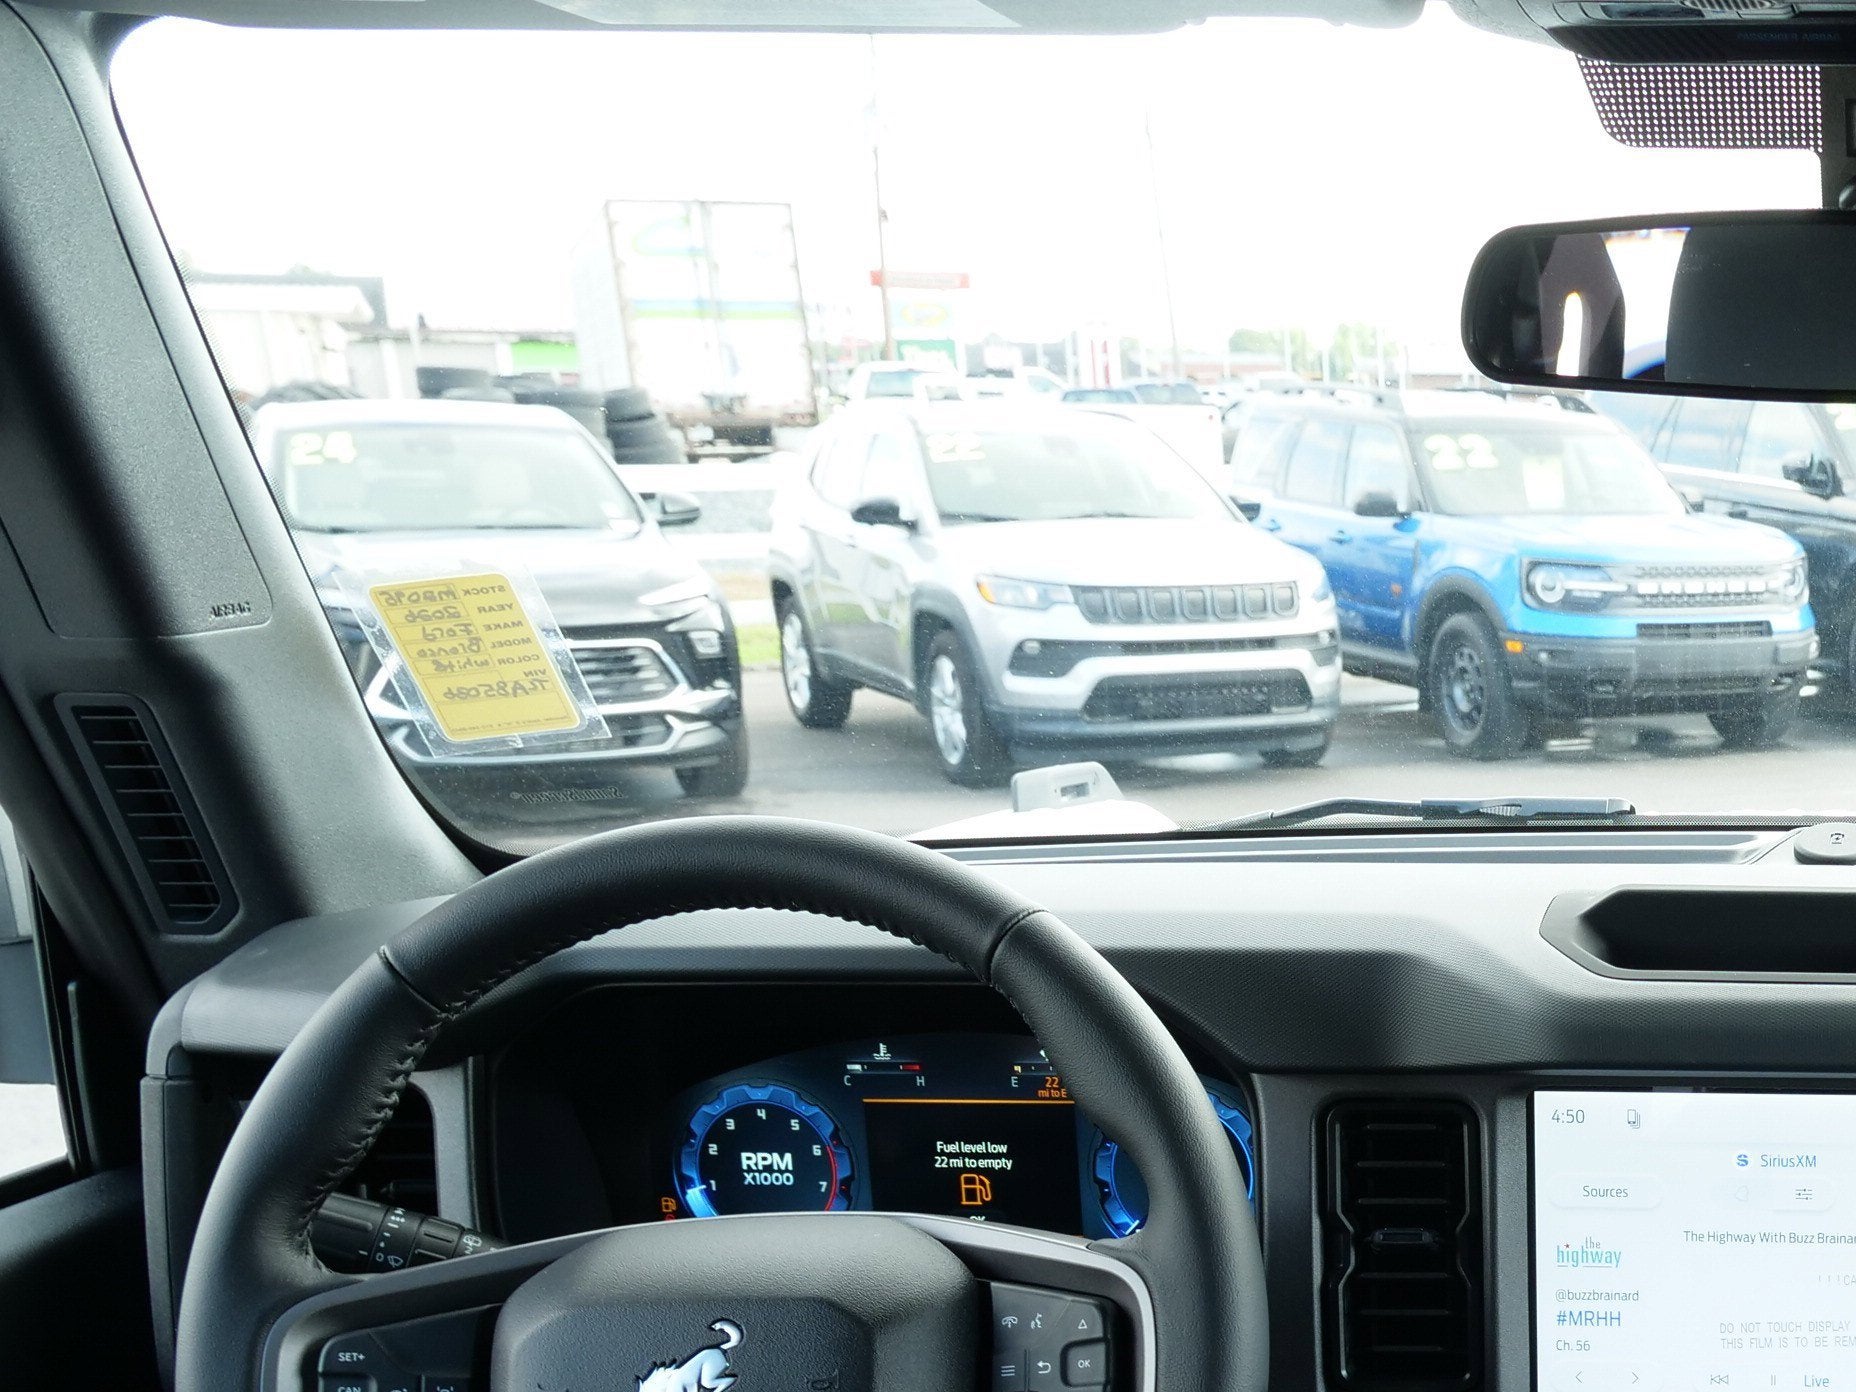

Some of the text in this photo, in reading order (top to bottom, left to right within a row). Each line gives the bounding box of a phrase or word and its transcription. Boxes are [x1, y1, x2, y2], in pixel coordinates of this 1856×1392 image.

[290, 431, 357, 467] 24
[1423, 433, 1499, 471] 22
[843, 1075, 851, 1087] C
[916, 1075, 925, 1087] H
[1010, 1077, 1018, 1088] E
[1045, 1076, 1059, 1088] 22
[1038, 1088, 1049, 1098] mi
[1050, 1089, 1059, 1098] to
[757, 1108, 766, 1119] 4
[1551, 1109, 1585, 1124] 4:50
[726, 1119, 735, 1130] 3
[790, 1119, 800, 1131] 5
[709, 1144, 718, 1155] 2
[812, 1145, 822, 1156] 6
[936, 1141, 1008, 1154] Fuel level low
[741, 1152, 793, 1171] RPM
[934, 1156, 1013, 1171] 22 mi to empty
[1760, 1154, 1818, 1168] SiriusXM
[743, 1173, 794, 1186] X1000
[818, 1181, 827, 1192] 7
[1582, 1185, 1629, 1199] Sources
[1584, 1236, 1601, 1250] the
[1683, 1230, 1704, 1243] The
[1707, 1231, 1756, 1245] Highway
[1758, 1231, 1787, 1244] With
[1788, 1232, 1815, 1244] Buzz
[1556, 1245, 1622, 1268] highway
[1555, 1289, 1639, 1302] @buzzbrainard
[1556, 1310, 1622, 1327] #MRHH
[1719, 1322, 1734, 1334] DO
[1740, 1322, 1761, 1334] NOT
[1767, 1321, 1802, 1334] TOUCH
[1808, 1320, 1850, 1333] DISPLAY
[1555, 1339, 1591, 1351] Ch. 56
[1720, 1337, 1743, 1349] THIS
[1750, 1337, 1773, 1349] FILM
[1779, 1336, 1788, 1349] IS
[1792, 1336, 1809, 1348] TO
[1814, 1336, 1829, 1348] BE
[338, 1351, 366, 1362] SET+
[1077, 1358, 1091, 1369] OK
[1804, 1375, 1830, 1388] Live
